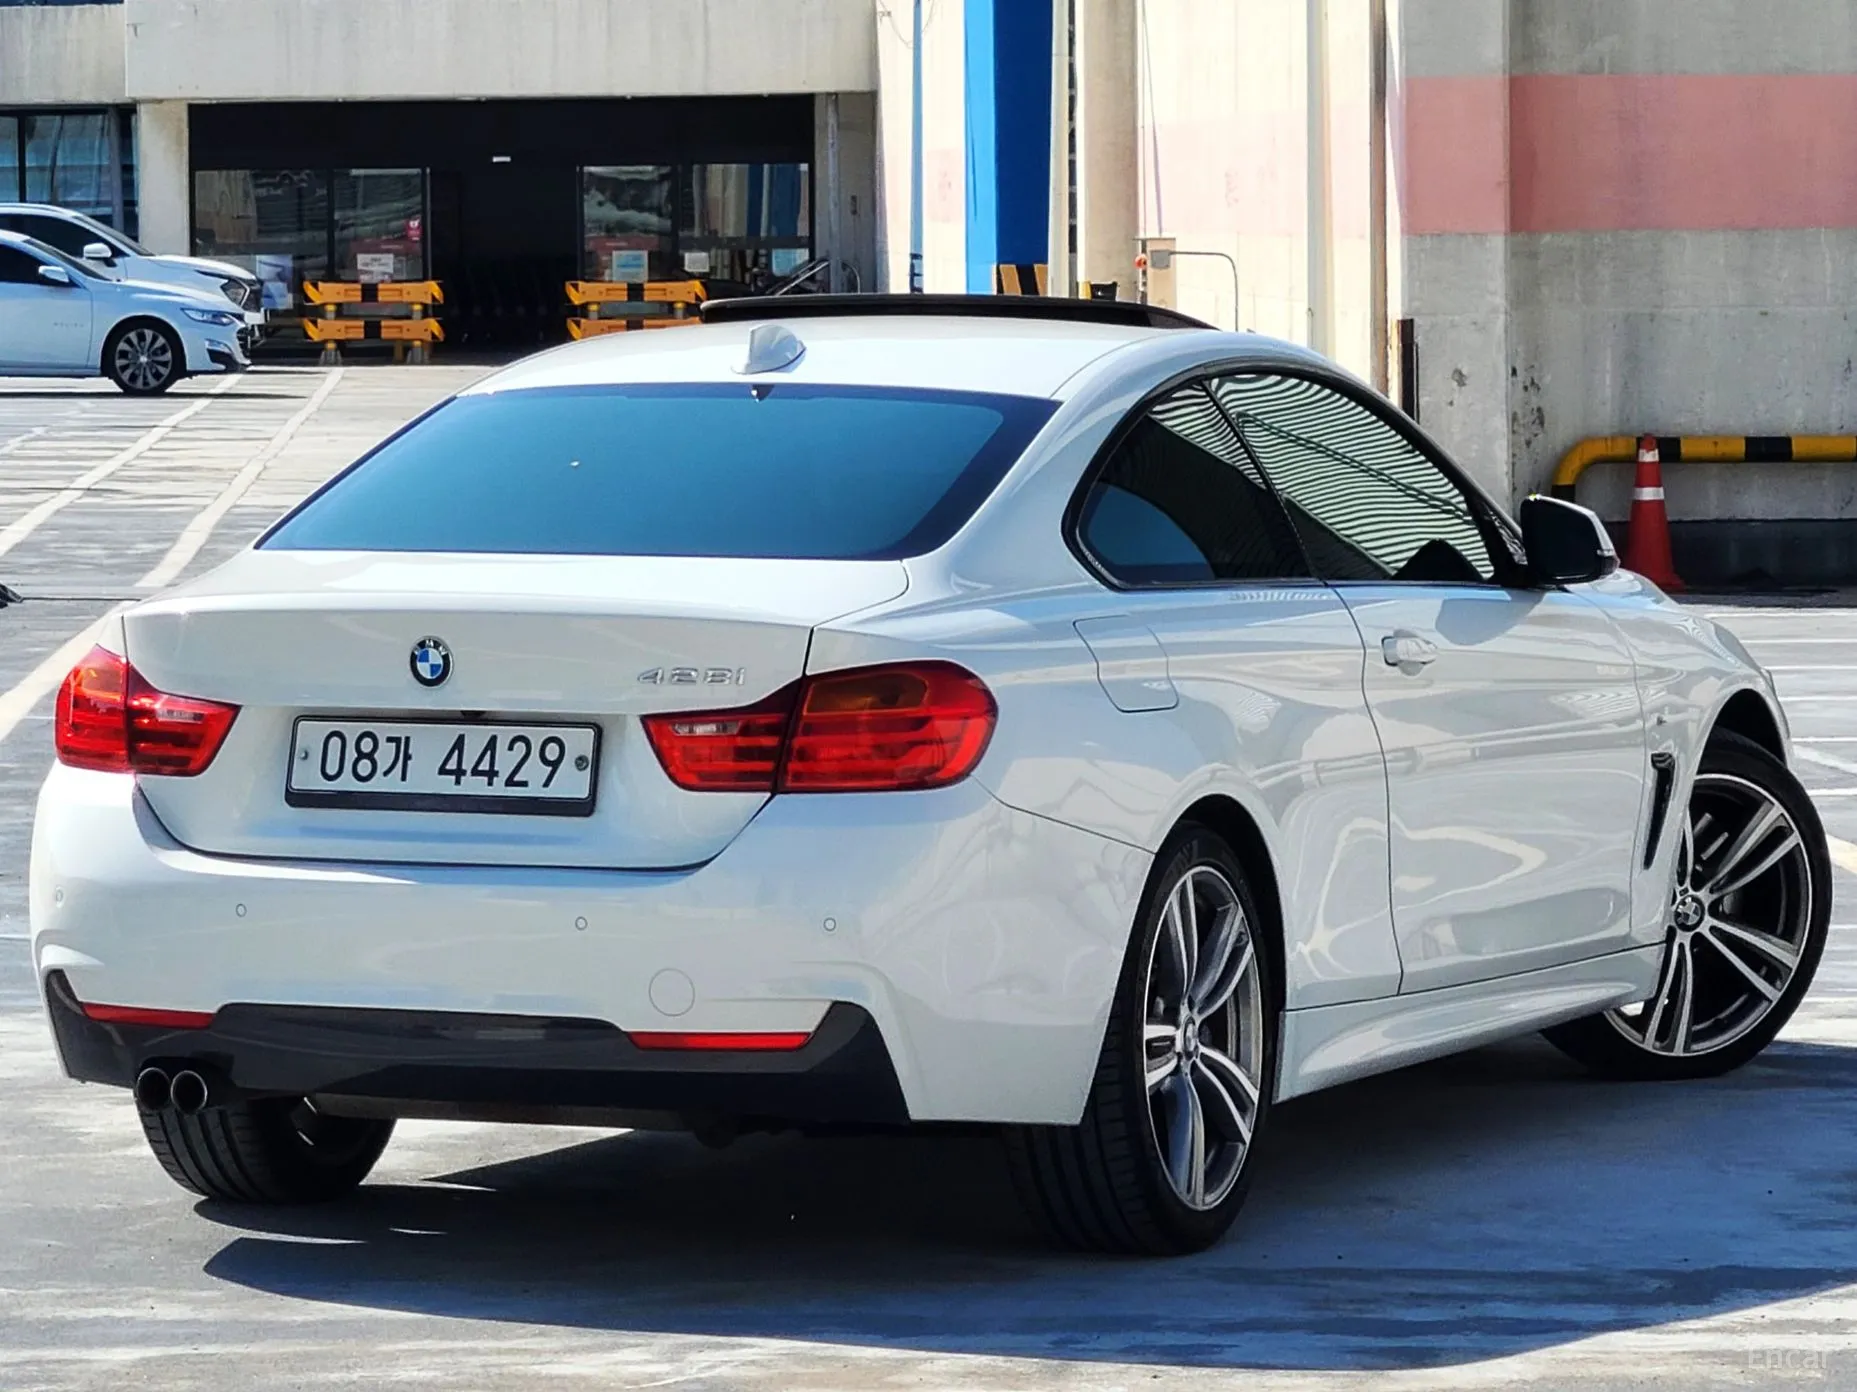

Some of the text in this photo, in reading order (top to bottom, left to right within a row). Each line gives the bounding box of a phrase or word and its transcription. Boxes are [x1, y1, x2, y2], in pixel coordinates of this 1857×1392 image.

[637, 666, 746, 686] 428i
[320, 730, 566, 788] 08가 4429
